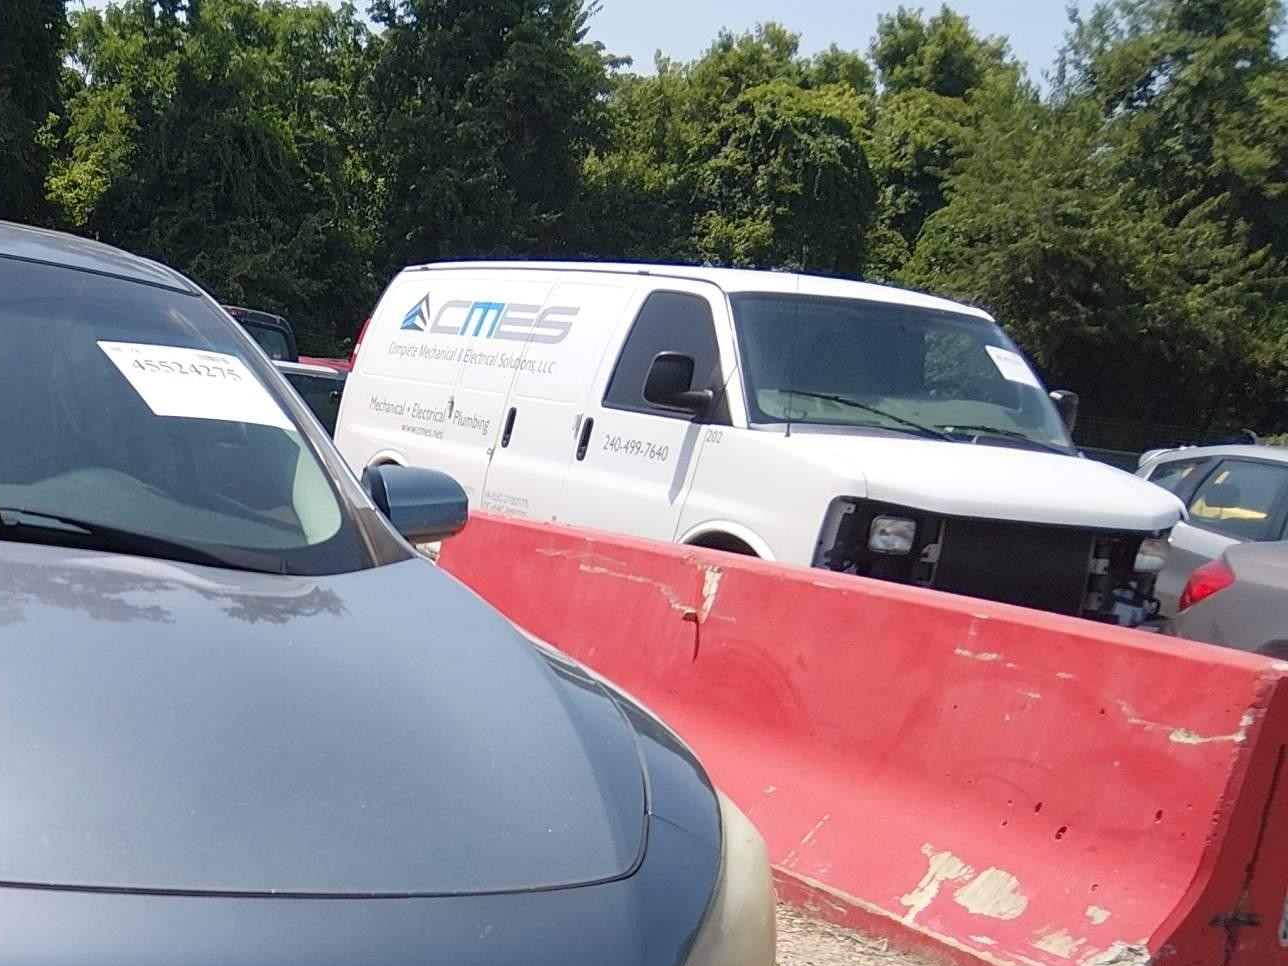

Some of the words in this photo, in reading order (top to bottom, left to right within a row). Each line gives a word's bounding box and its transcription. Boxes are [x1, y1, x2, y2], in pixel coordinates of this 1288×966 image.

[429, 299, 581, 345] CMES
[132, 358, 242, 382] 45524275
[388, 341, 419, 359] Complete
[418, 343, 457, 362] Mechanical
[463, 348, 497, 367] Electrical
[538, 360, 557, 375] LLC
[369, 395, 406, 416] Mechanical
[411, 402, 447, 423] Electrical
[452, 409, 491, 436] Plumbing
[603, 434, 669, 462] 240-499-7640
[706, 430, 723, 444] 202
